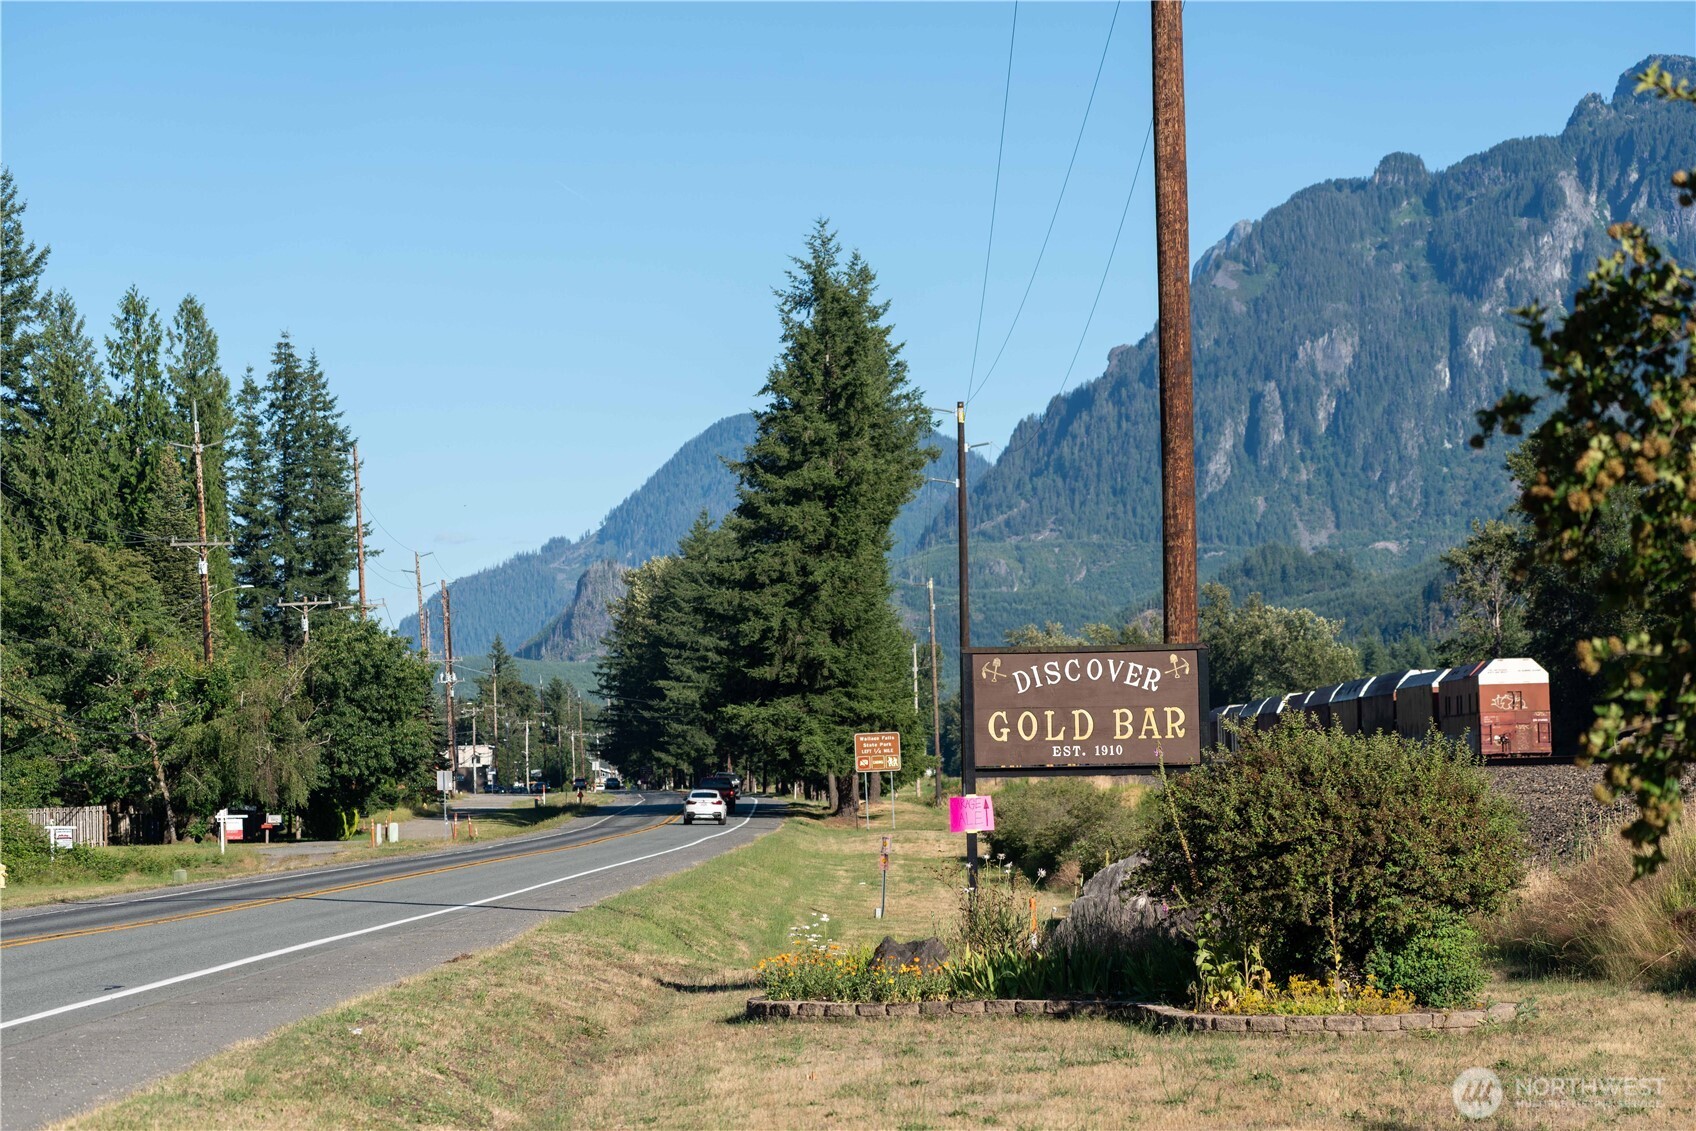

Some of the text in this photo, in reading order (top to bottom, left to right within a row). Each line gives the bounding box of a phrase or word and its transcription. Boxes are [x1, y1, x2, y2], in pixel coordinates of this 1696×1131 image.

[1012, 658, 1161, 694] DISCOVER
[988, 707, 1186, 742] GOLD BAR
[1052, 744, 1123, 757] EST. 1910
[955, 797, 982, 810] RAGE
[957, 810, 984, 827] ALE
